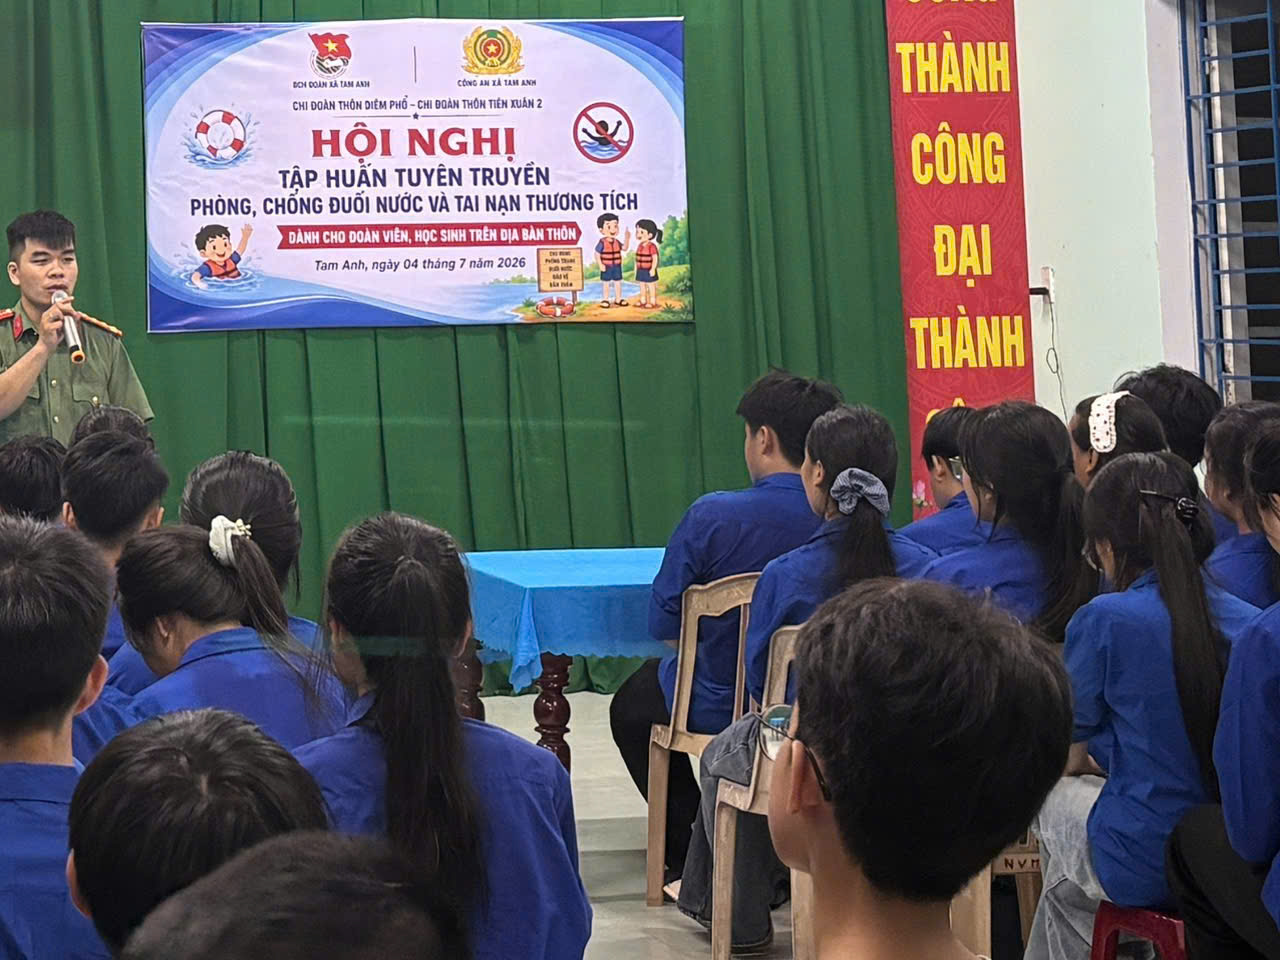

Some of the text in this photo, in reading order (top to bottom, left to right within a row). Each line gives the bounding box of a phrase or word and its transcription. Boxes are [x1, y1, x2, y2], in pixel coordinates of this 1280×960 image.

[895, 30, 1011, 93] THÀNH
[480, 79, 489, 87] AN
[293, 100, 308, 111] CHI
[311, 98, 335, 110] ĐOÀN
[338, 98, 362, 110] THÔN
[417, 100, 432, 109] CHI
[435, 98, 459, 109] ĐOÀN
[462, 97, 486, 109] THÔN
[510, 97, 535, 108] XUÂN
[537, 99, 543, 108] 2
[312, 122, 516, 164] HỘI NGHỊ
[910, 121, 1007, 185] CÔNG
[278, 161, 550, 192] TẬP HUẤN TUYÊN TRUYỀN
[190, 188, 638, 218] PHÒNG, CHỐNG ĐUỐI NƯỚC VÀ TAI NẠN THƯƠNG TÍCH
[288, 224, 577, 245] DÀNH CHO ĐOÀN VIÊN, HỌC SINH TRÊN ĐỊA BÀN THÔN
[315, 257, 526, 272] Tam Anh, ngày 04 tháng 7 năm 2026
[933, 224, 993, 288] ĐẠI
[909, 304, 1026, 369] THÀNH
